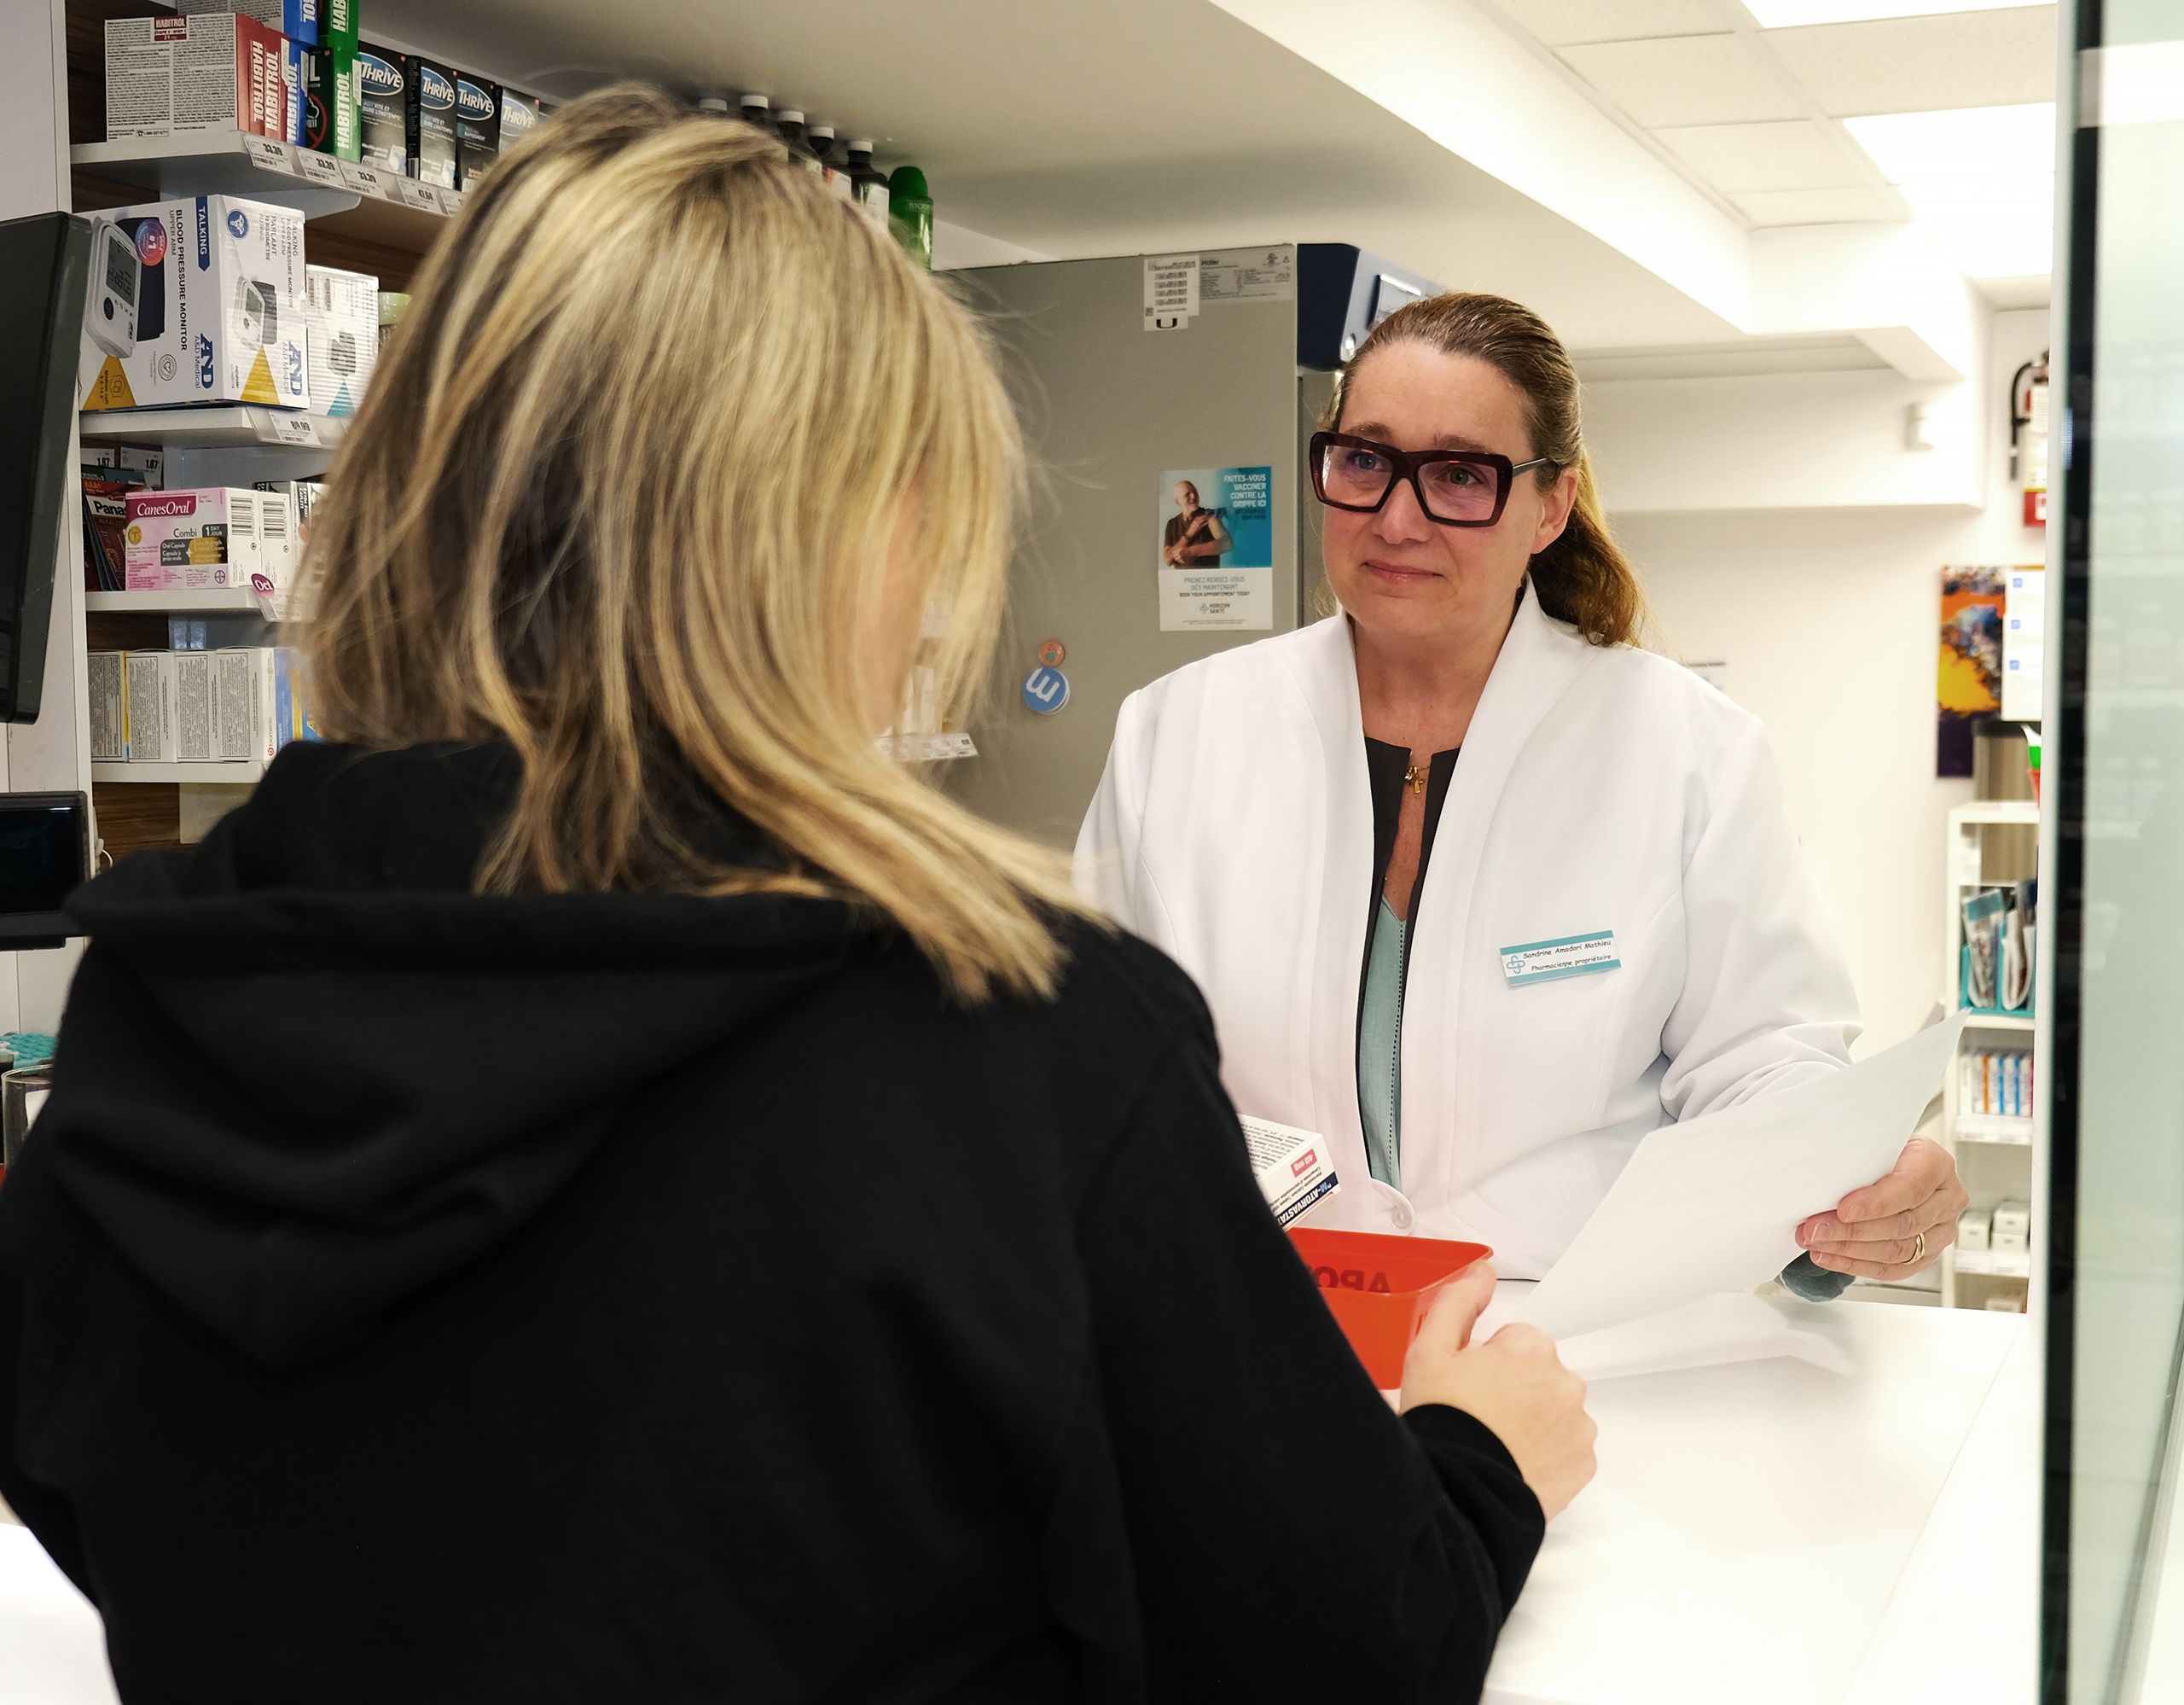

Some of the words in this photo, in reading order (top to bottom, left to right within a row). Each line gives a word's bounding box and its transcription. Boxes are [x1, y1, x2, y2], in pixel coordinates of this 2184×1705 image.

[155, 18, 186, 28] HABITROL
[253, 40, 264, 122] HABITROL
[362, 62, 402, 89] THRIVE
[265, 51, 279, 131] HABITROL
[423, 76, 455, 102] THRIVE
[458, 89, 492, 113] THRIVE
[288, 63, 298, 141] HABITROL
[337, 72, 350, 149] HABITROL
[502, 105, 535, 128] THRIVE
[176, 209, 184, 244] BLOOD
[198, 207, 207, 255] TALKING
[177, 248, 186, 300] PRESSURE
[200, 333, 213, 389] AND
[288, 341, 303, 396] AND
[97, 457, 110, 467] 1.87
[146, 459, 158, 469] 1.87
[1224, 474, 1266, 482] FAITES-VOUS
[93, 500, 126, 515] Pana
[137, 500, 190, 516] CanesOral
[173, 527, 197, 538] Combi
[206, 527, 210, 536] 1
[1523, 950, 1552, 959] Sandrine
[1555, 946, 1582, 954] Amadori
[1584, 940, 1612, 949] Mathieu
[1531, 961, 1572, 971] Pharmacienne
[1574, 954, 1612, 966] propriétaire
